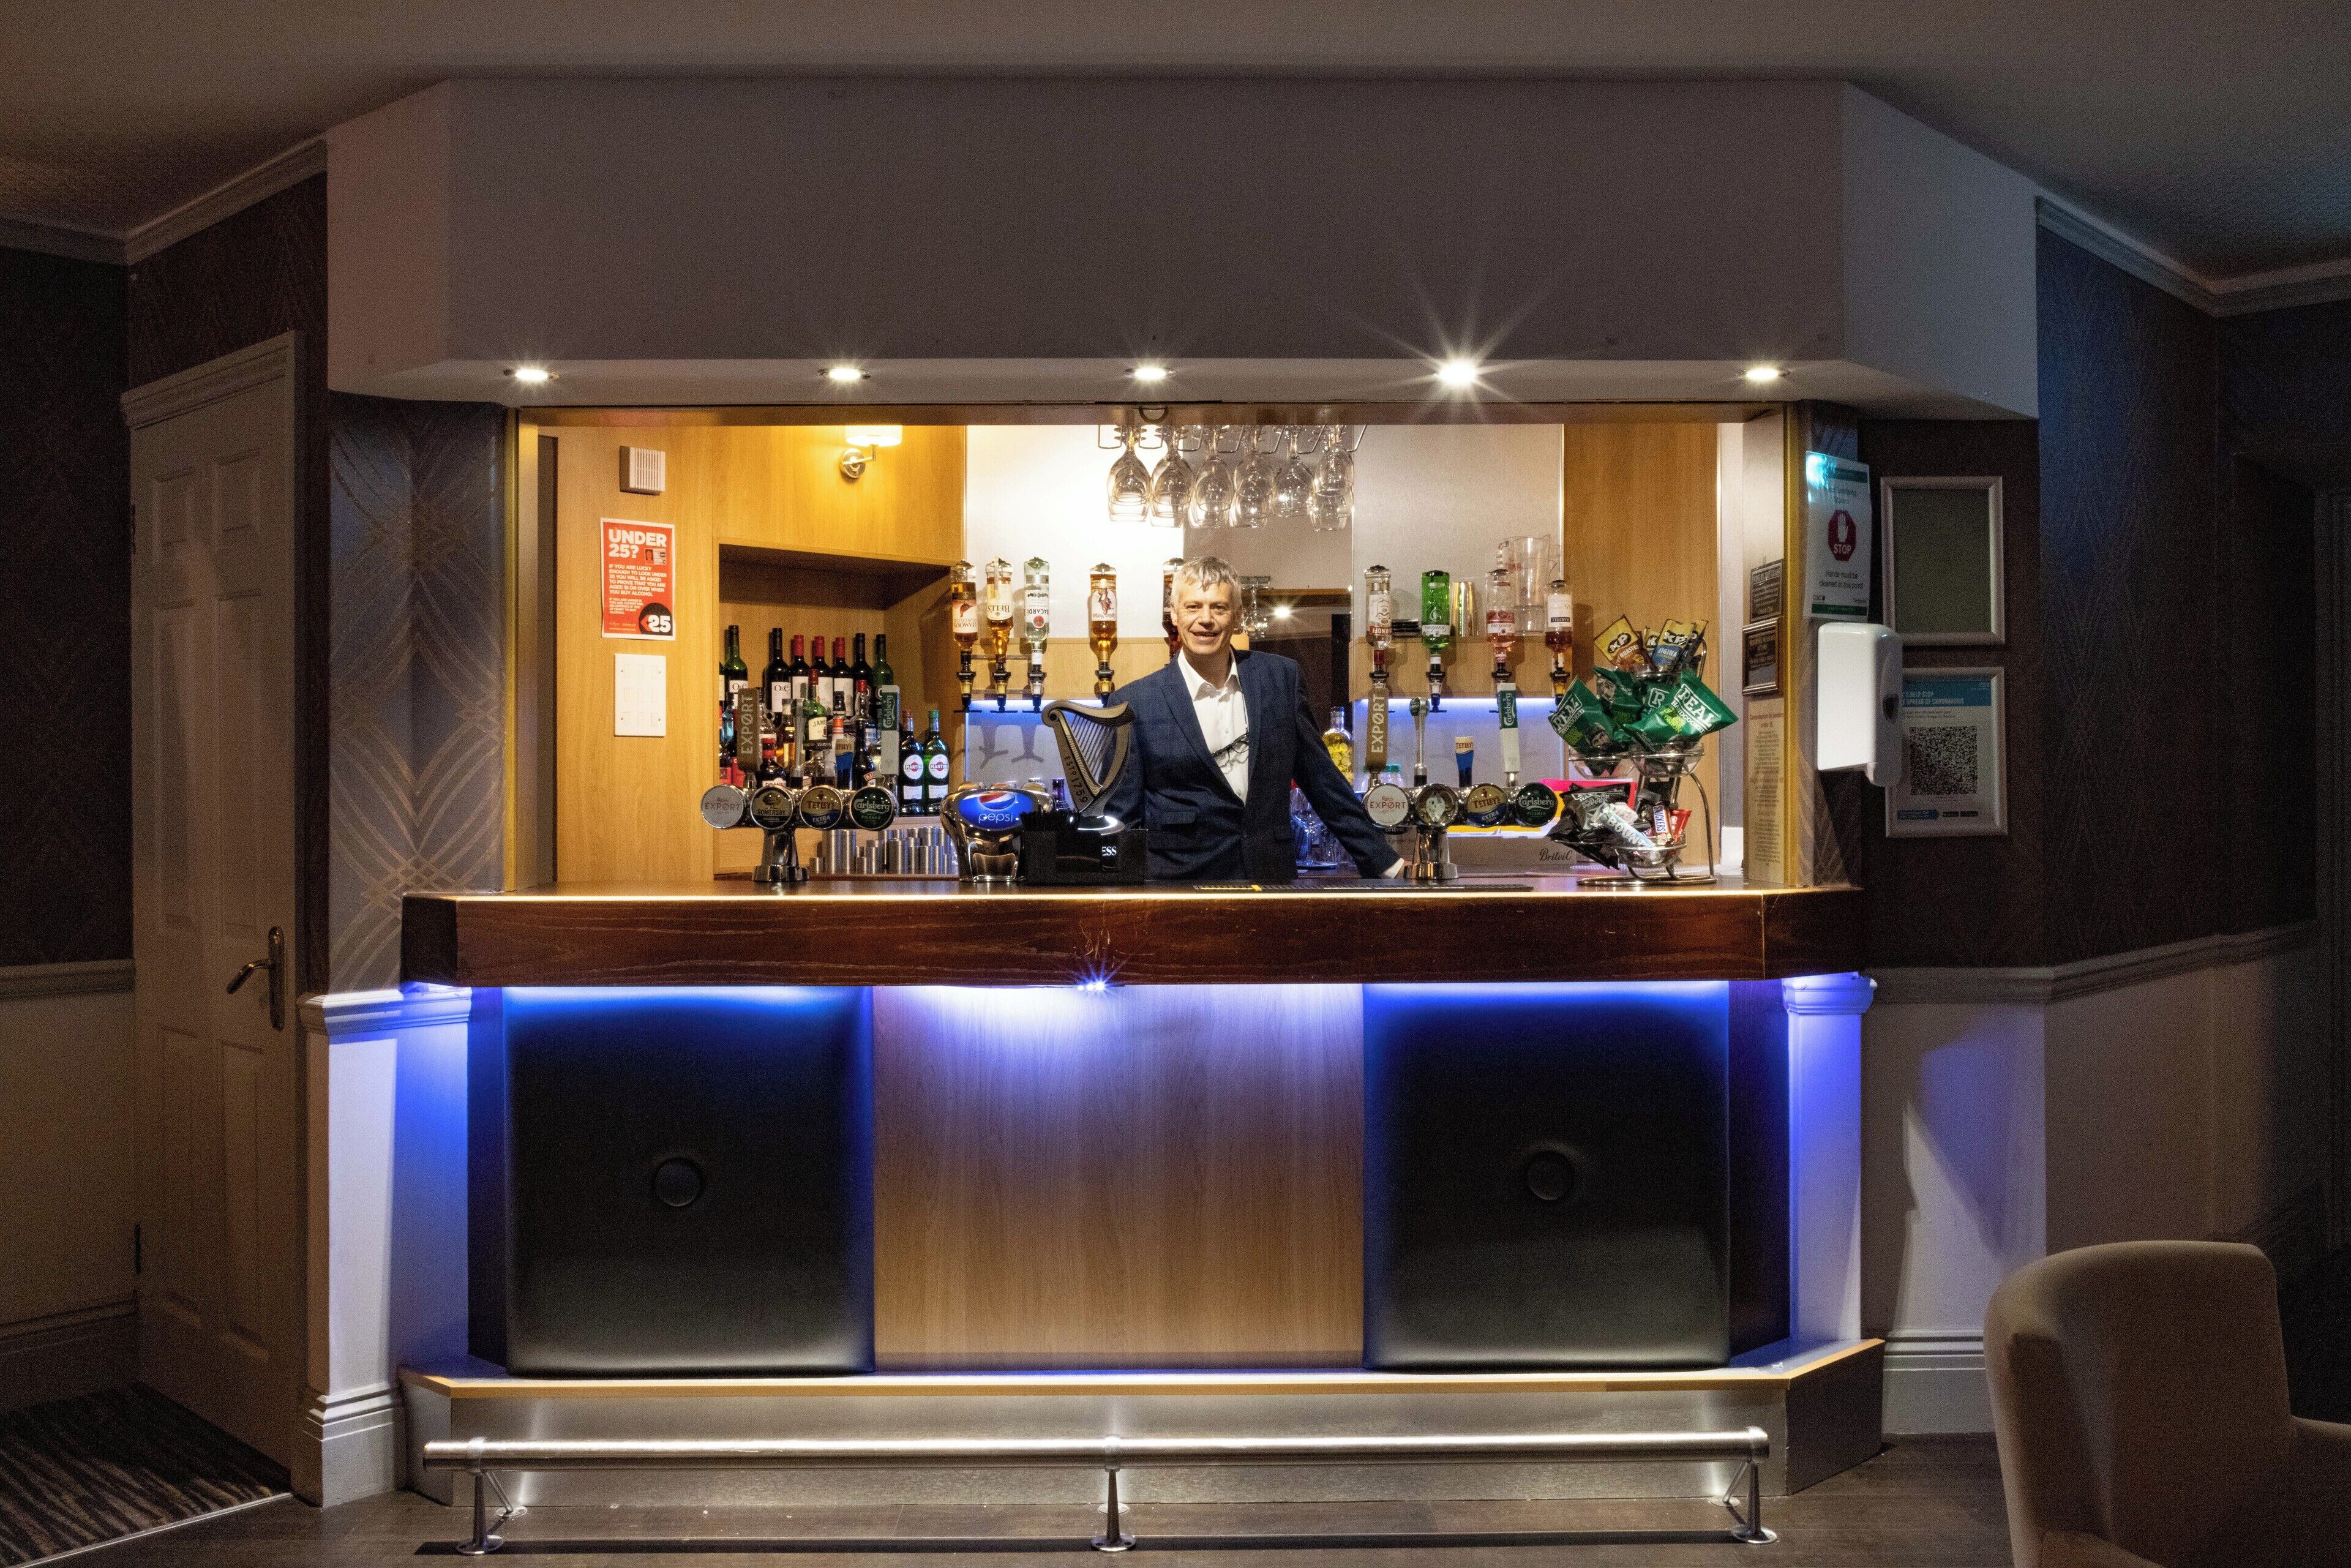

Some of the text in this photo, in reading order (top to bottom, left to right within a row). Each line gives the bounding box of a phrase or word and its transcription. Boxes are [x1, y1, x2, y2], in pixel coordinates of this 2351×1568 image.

[608, 528, 667, 547] UNDER
[608, 543, 639, 558] 25?
[1834, 544, 1851, 554] STOP
[648, 614, 671, 633] 25
[1610, 633, 1629, 653] KP
[1663, 631, 1688, 644] KP
[882, 694, 896, 729] Carlsberg
[1502, 692, 1514, 726] Carlsberg
[1553, 696, 1581, 730] REAL
[1678, 685, 1713, 729] REAL
[1070, 778, 1088, 803] 1759
[853, 798, 890, 812] Carlsberg
[1518, 795, 1555, 809] Carlsberg
[978, 811, 1014, 823] pepsi
[1481, 810, 1500, 821] EXTRA
[1654, 806, 1667, 831] SNICKERS
